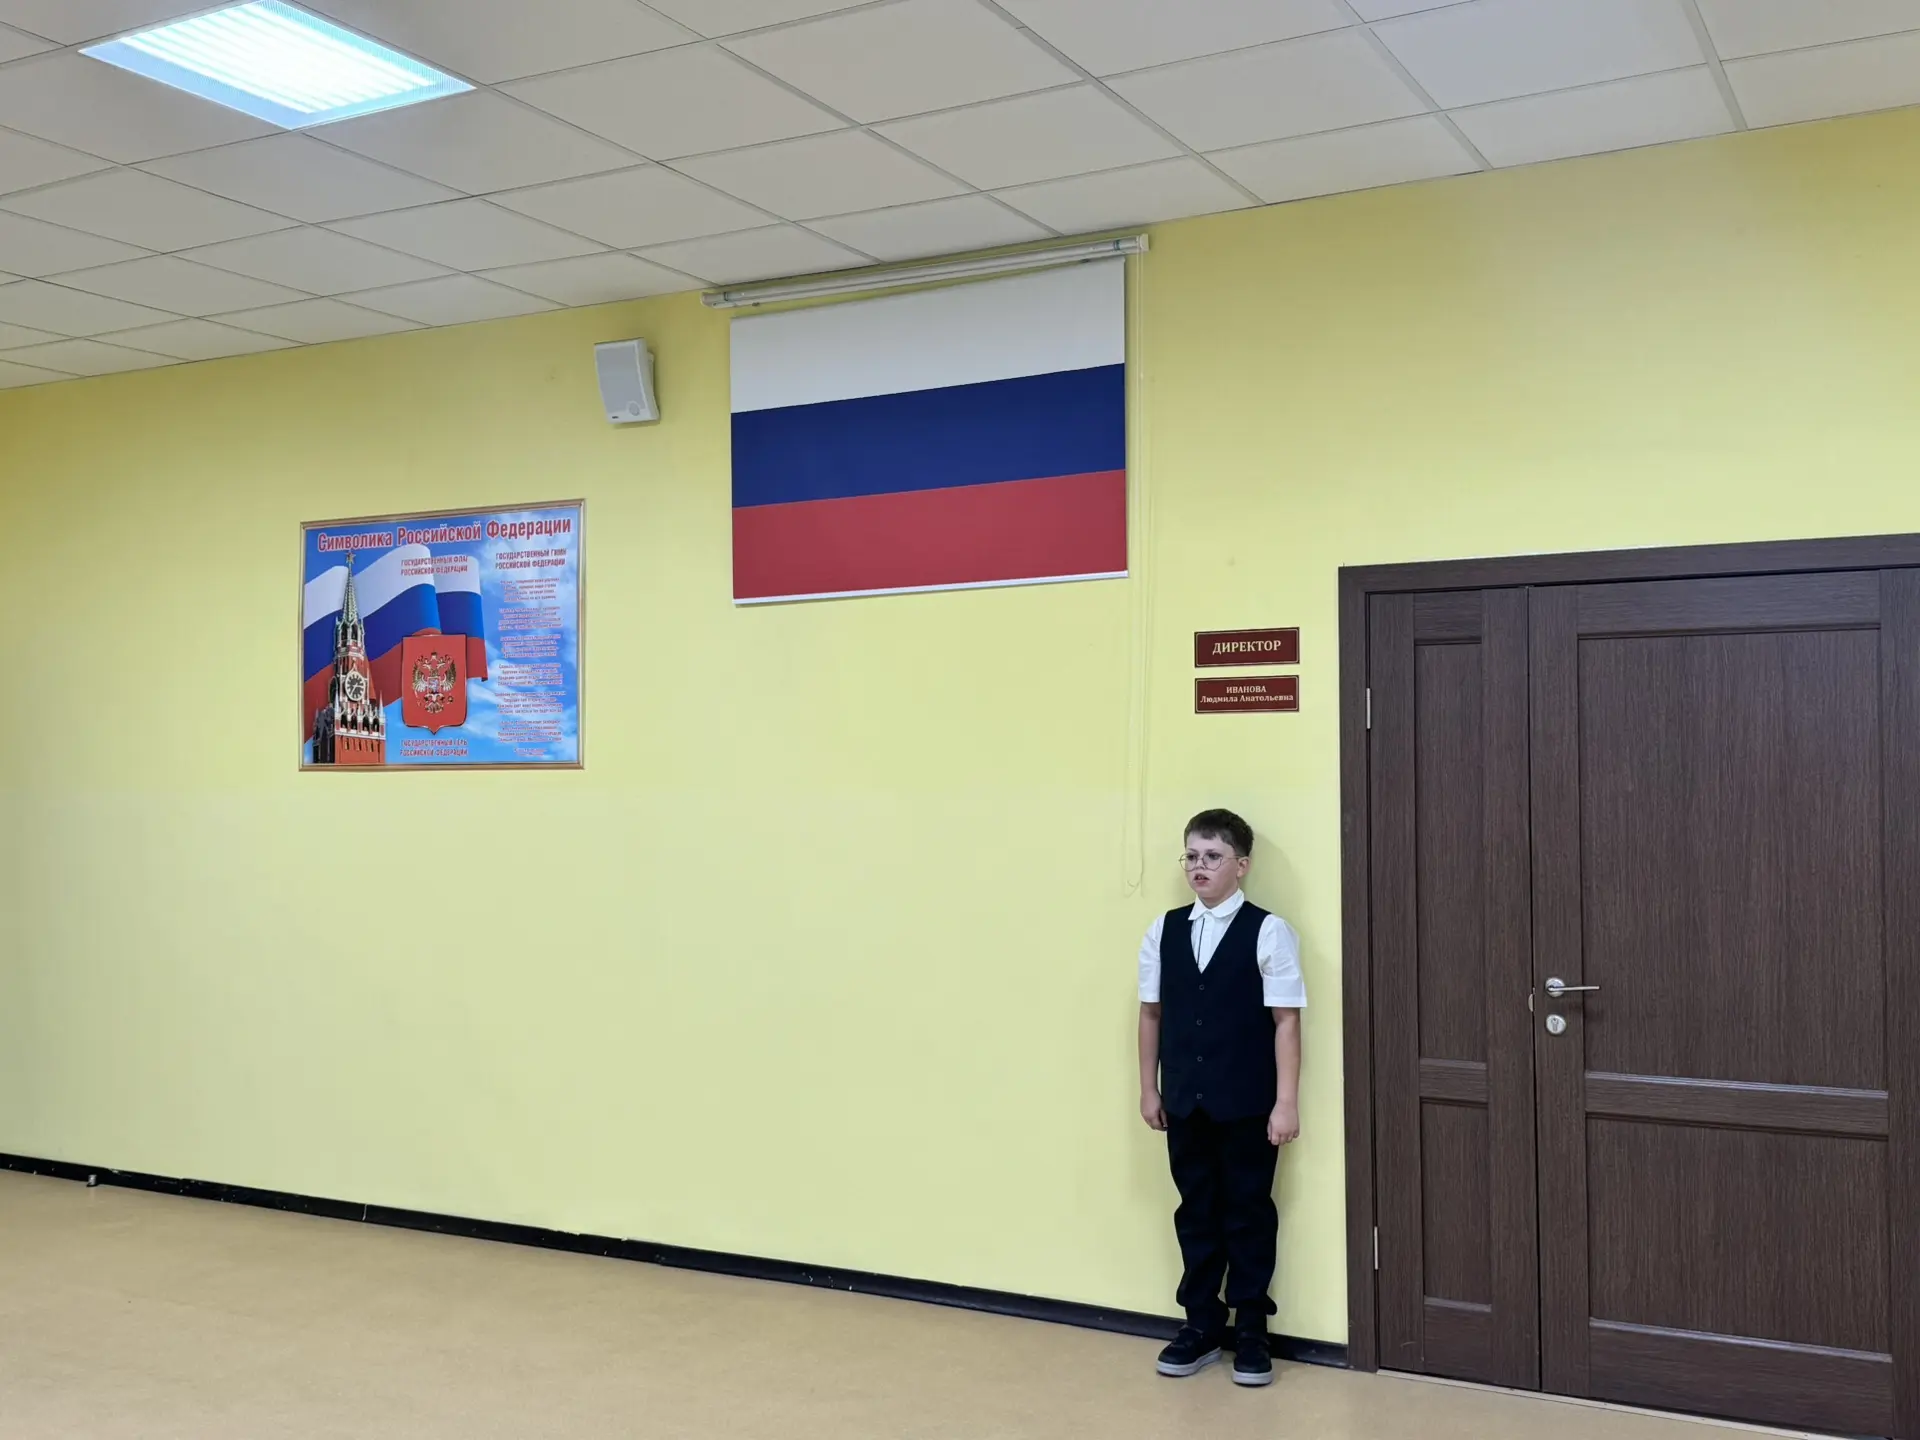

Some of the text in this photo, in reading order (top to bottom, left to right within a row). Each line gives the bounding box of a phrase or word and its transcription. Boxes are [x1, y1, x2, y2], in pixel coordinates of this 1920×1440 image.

[318, 517, 571, 552] Символика Российской Федерации
[496, 548, 567, 560] ГОСУДАРСТВЕННЫЙ ГИМН
[401, 557, 453, 566] ГОСУДАРСТВЕННЫЙ
[495, 558, 566, 570] РОССИЙСКОЙ ФЕДЕРАЦИИ
[400, 565, 468, 576] РОССИЙСКОЙ ФЕДЕРАЦИИ
[1212, 640, 1282, 655] ДИРЕКТОР
[1226, 685, 1267, 694] ИВАНОВА
[1200, 694, 1294, 704] Людмила Анатольевна
